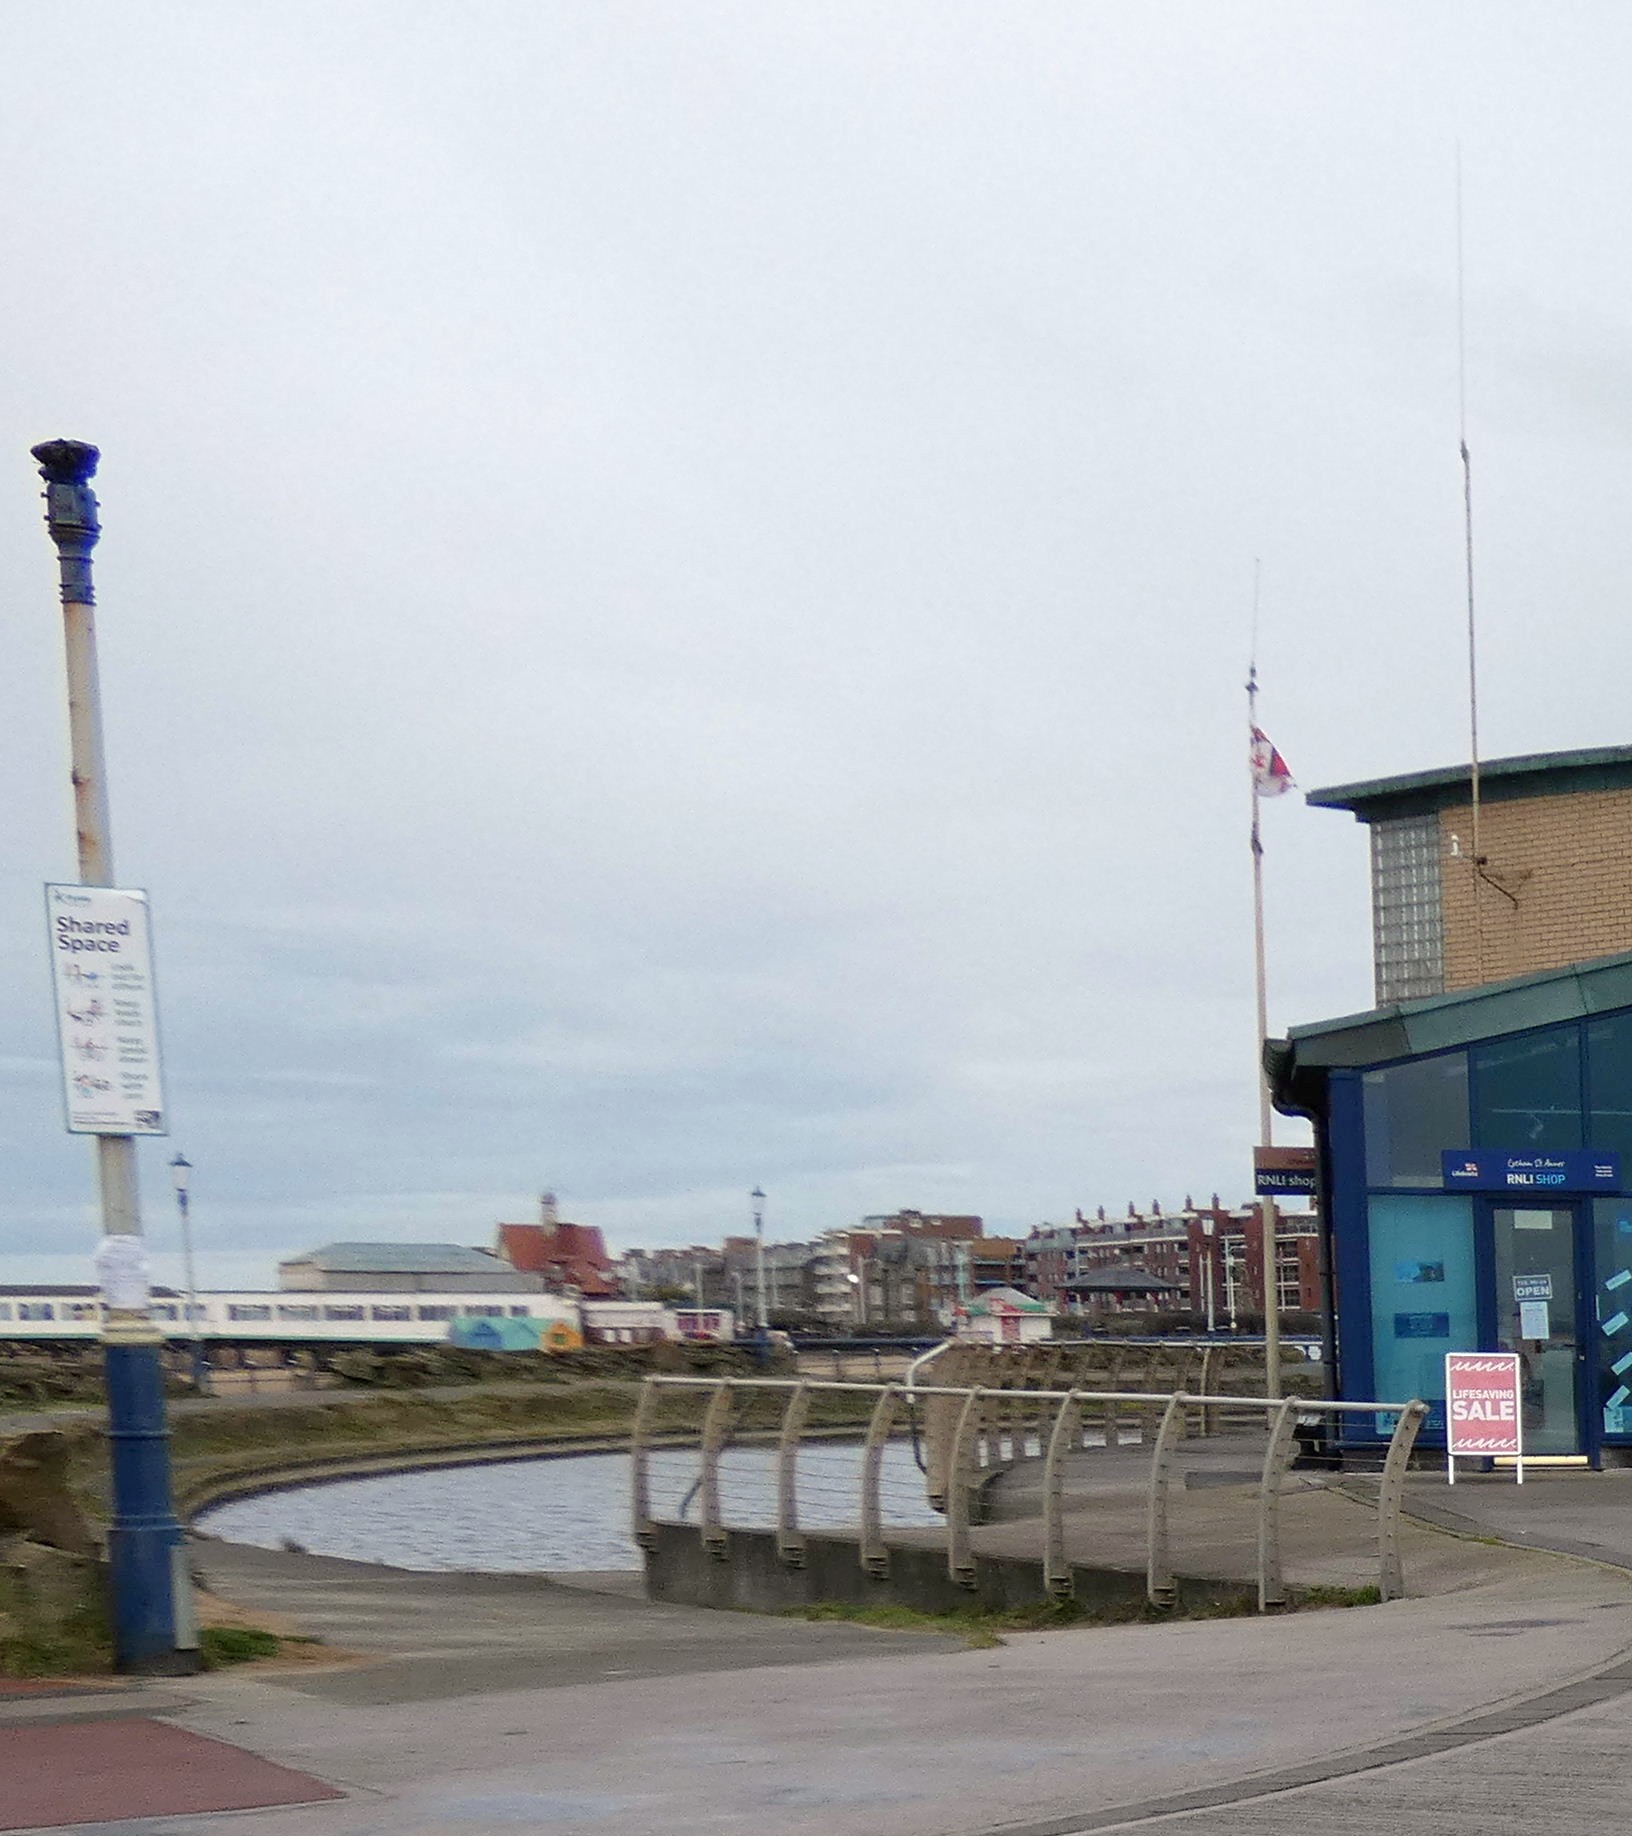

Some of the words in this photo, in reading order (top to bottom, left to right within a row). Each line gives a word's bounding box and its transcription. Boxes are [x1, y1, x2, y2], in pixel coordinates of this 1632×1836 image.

[57, 915, 130, 935] Shared
[57, 934, 120, 953] Space
[1257, 1174, 1286, 1186] RNLI
[1289, 1175, 1317, 1189] shop
[1507, 1174, 1534, 1185] RNLI
[1536, 1174, 1566, 1185] SHOP
[1517, 1286, 1550, 1297] OPEN
[1452, 1389, 1514, 1399] LIFESAVING
[1452, 1400, 1515, 1421] SALE
